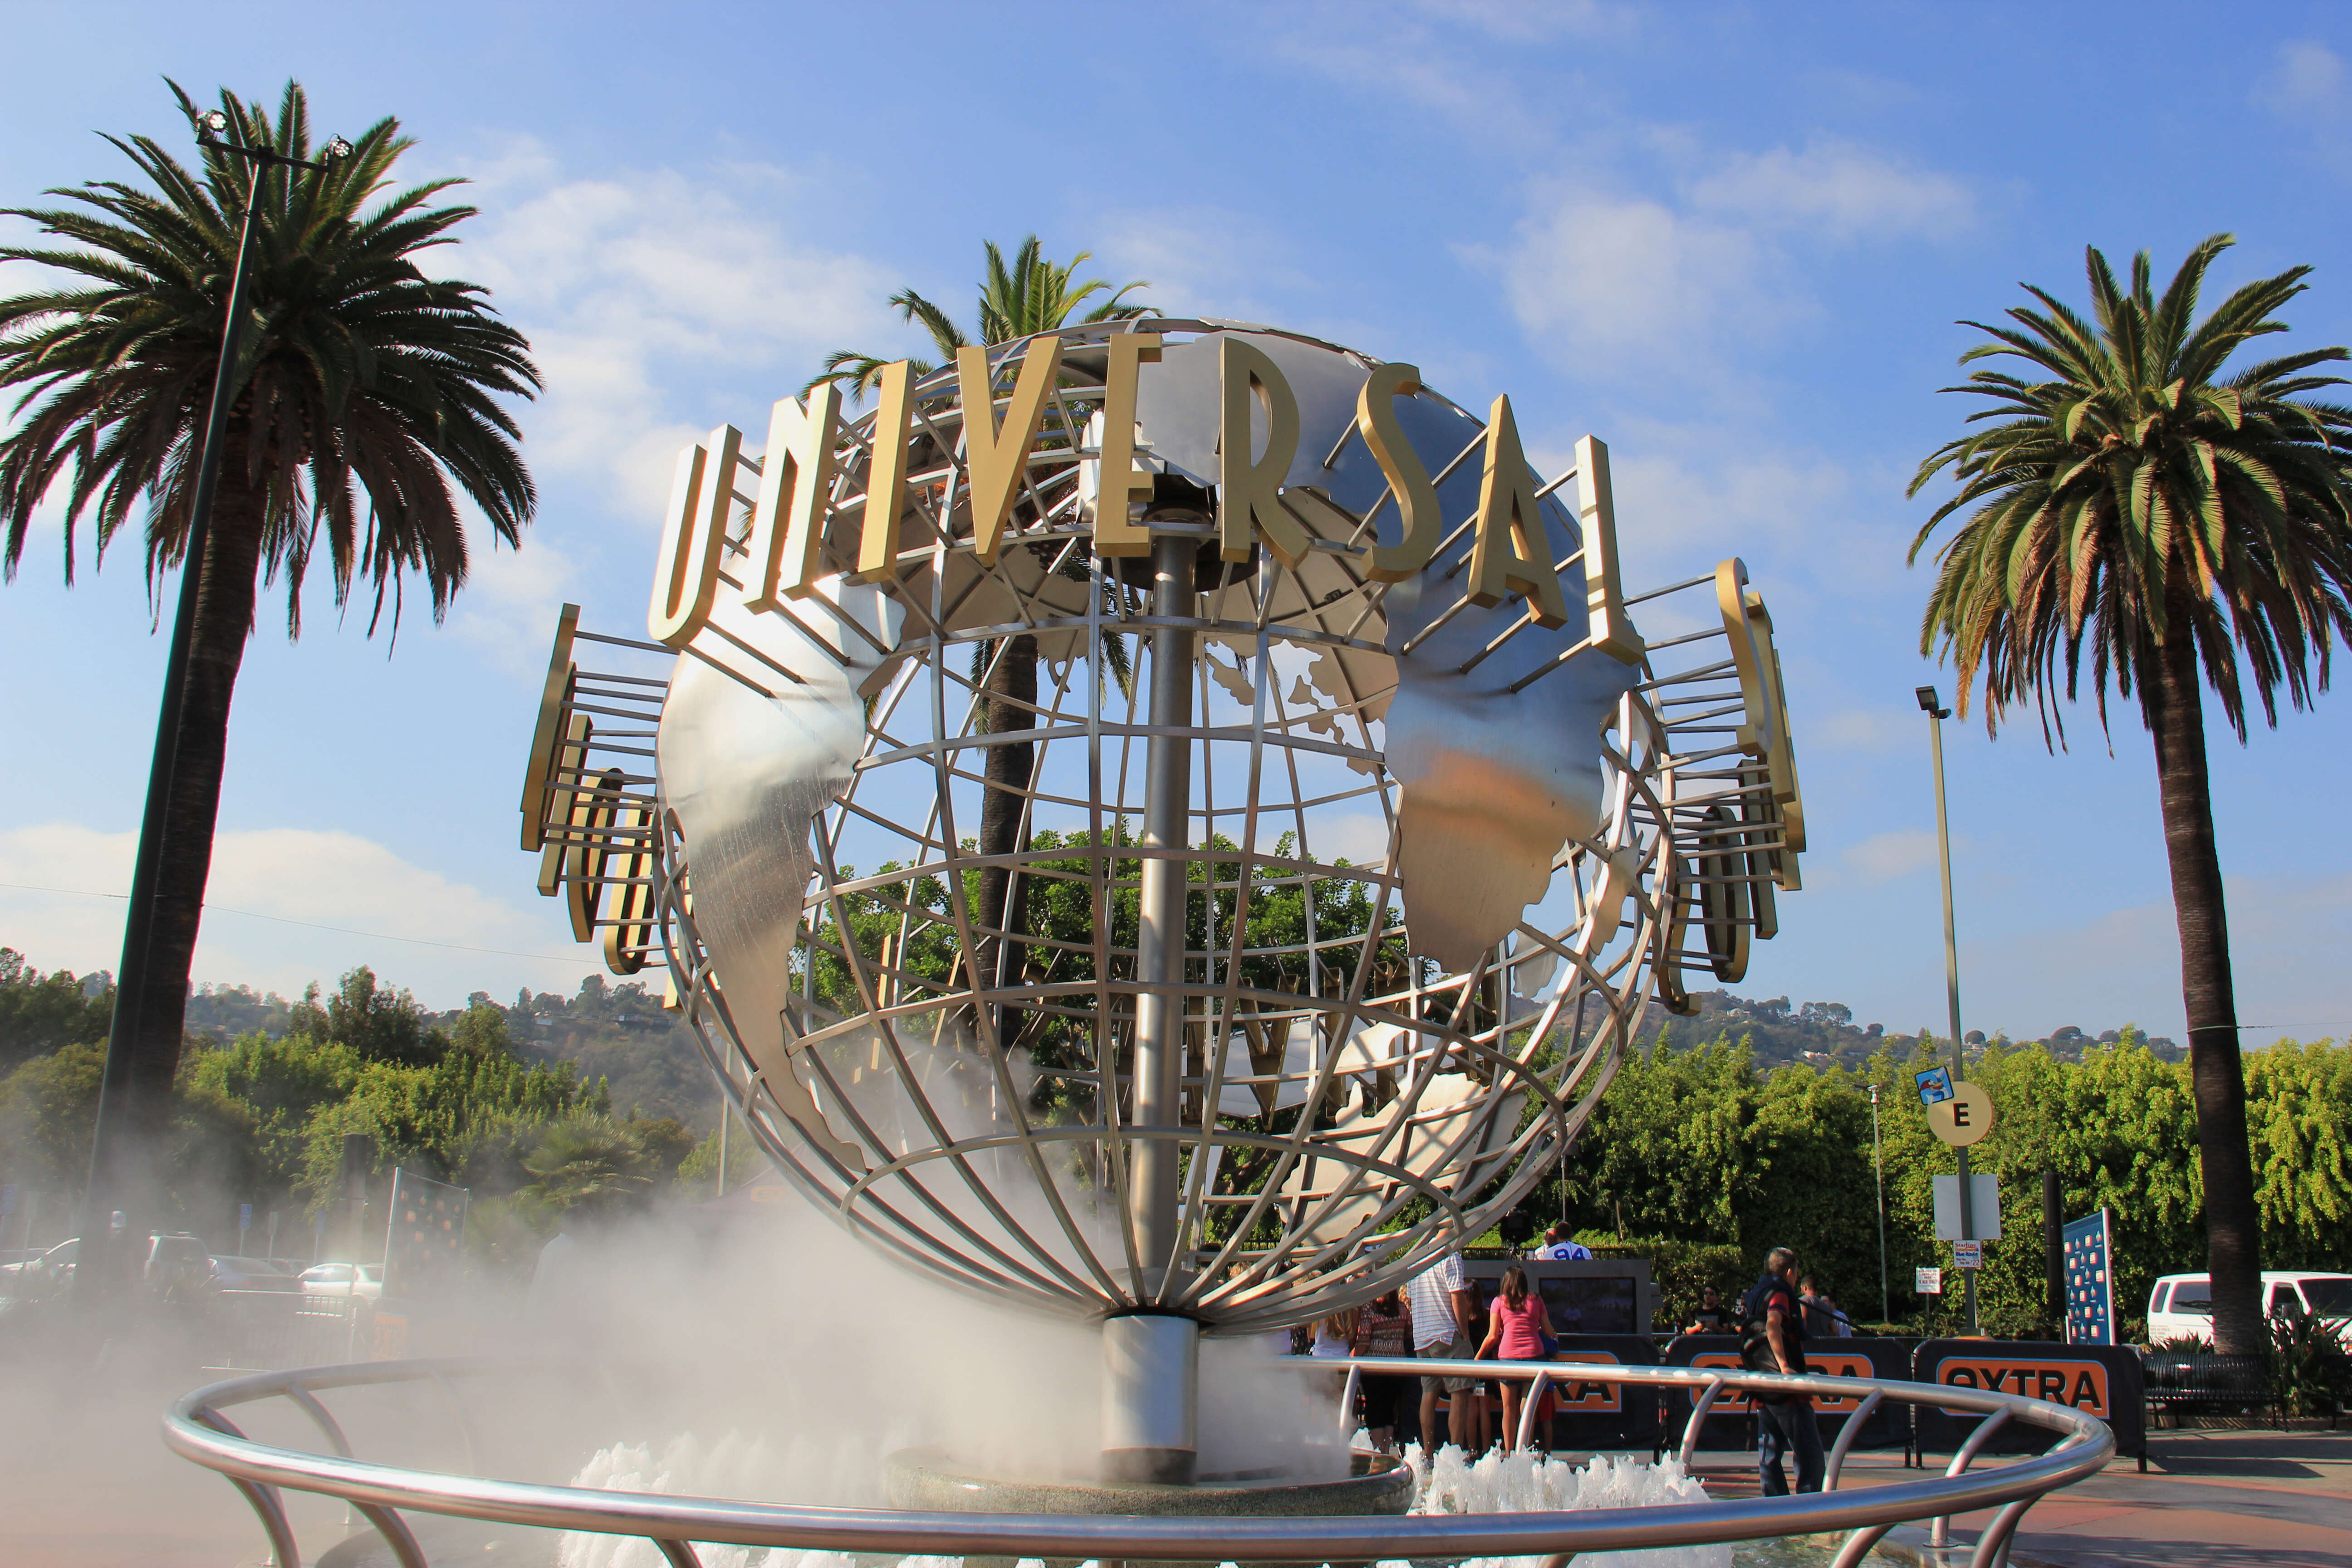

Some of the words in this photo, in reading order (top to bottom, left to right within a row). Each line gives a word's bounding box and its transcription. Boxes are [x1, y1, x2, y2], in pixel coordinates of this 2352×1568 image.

[647, 331, 1646, 666] UNIVERSAL
[1953, 1102, 1970, 1127] E
[1554, 1248, 1585, 1260] 94
